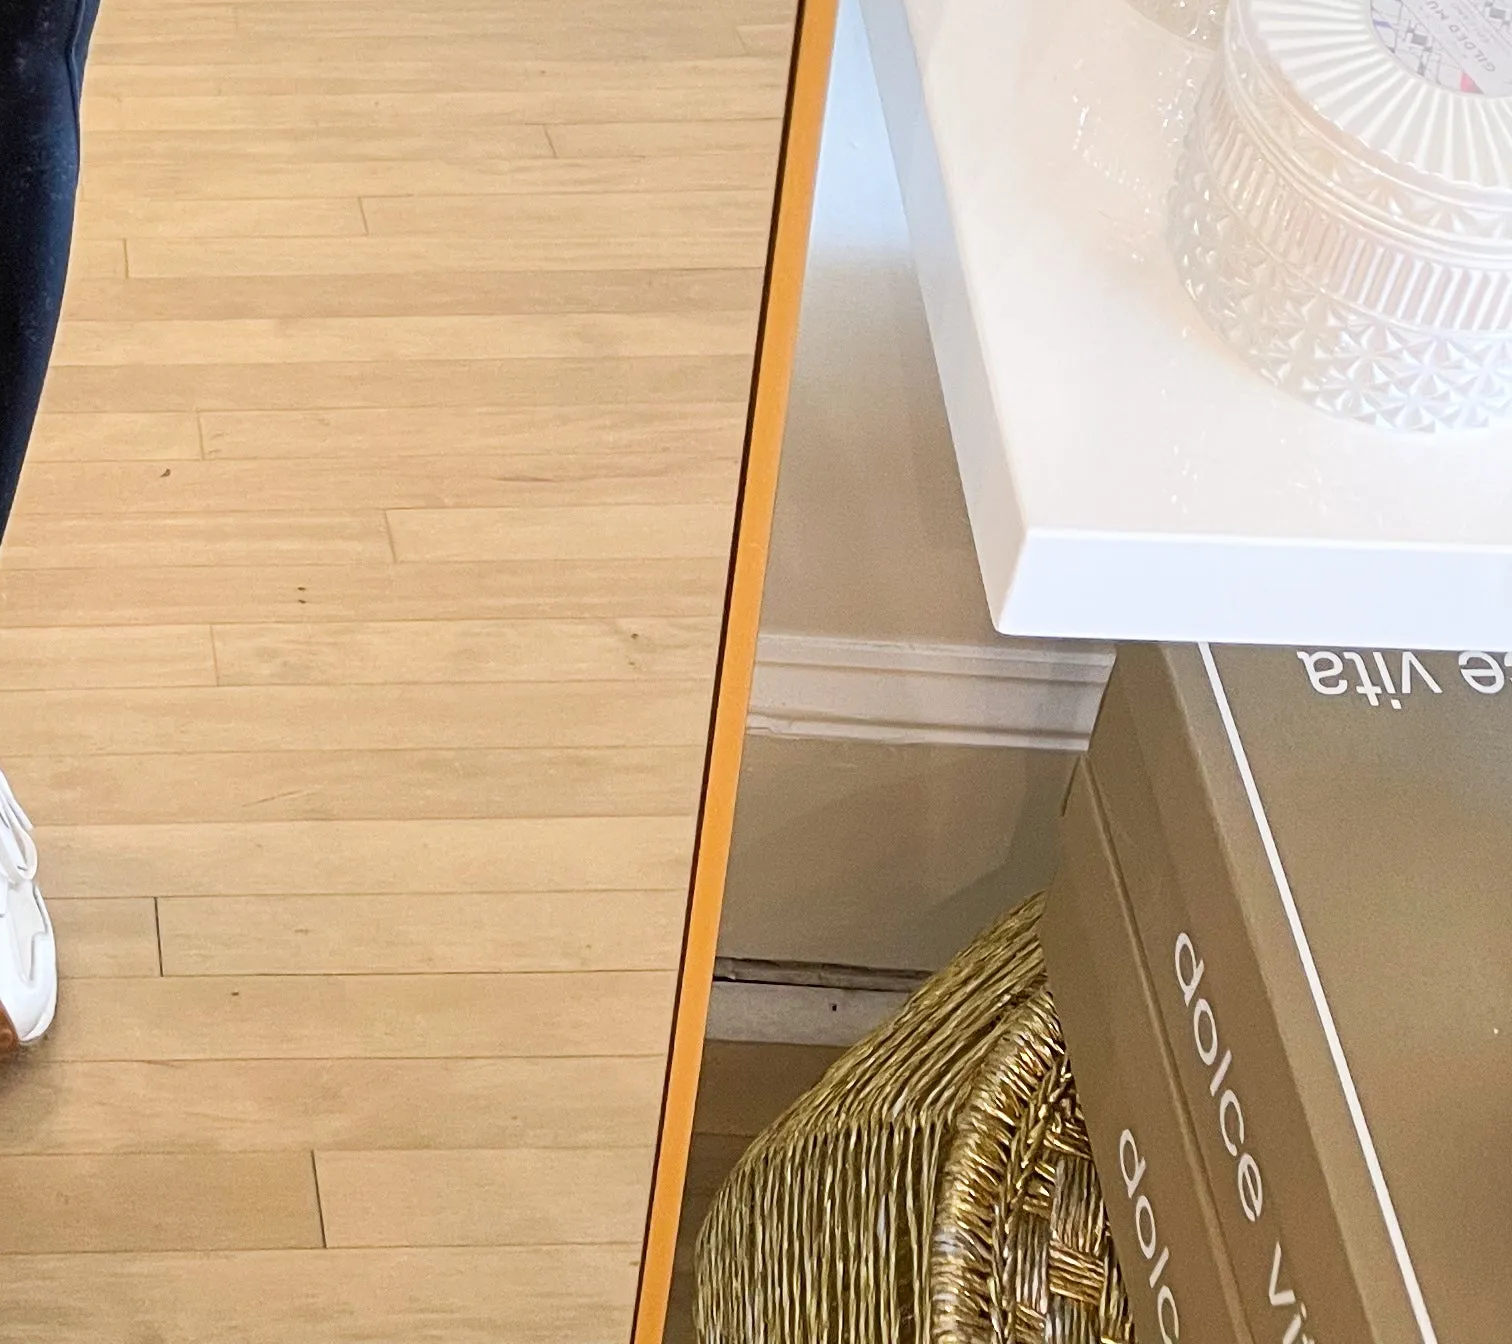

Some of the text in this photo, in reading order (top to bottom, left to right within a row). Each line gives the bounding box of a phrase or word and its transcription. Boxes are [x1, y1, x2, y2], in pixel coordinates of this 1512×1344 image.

[1448, 23, 1496, 73] GILDED
[1296, 651, 1444, 710] vita
[1174, 932, 1264, 1222] dolce
